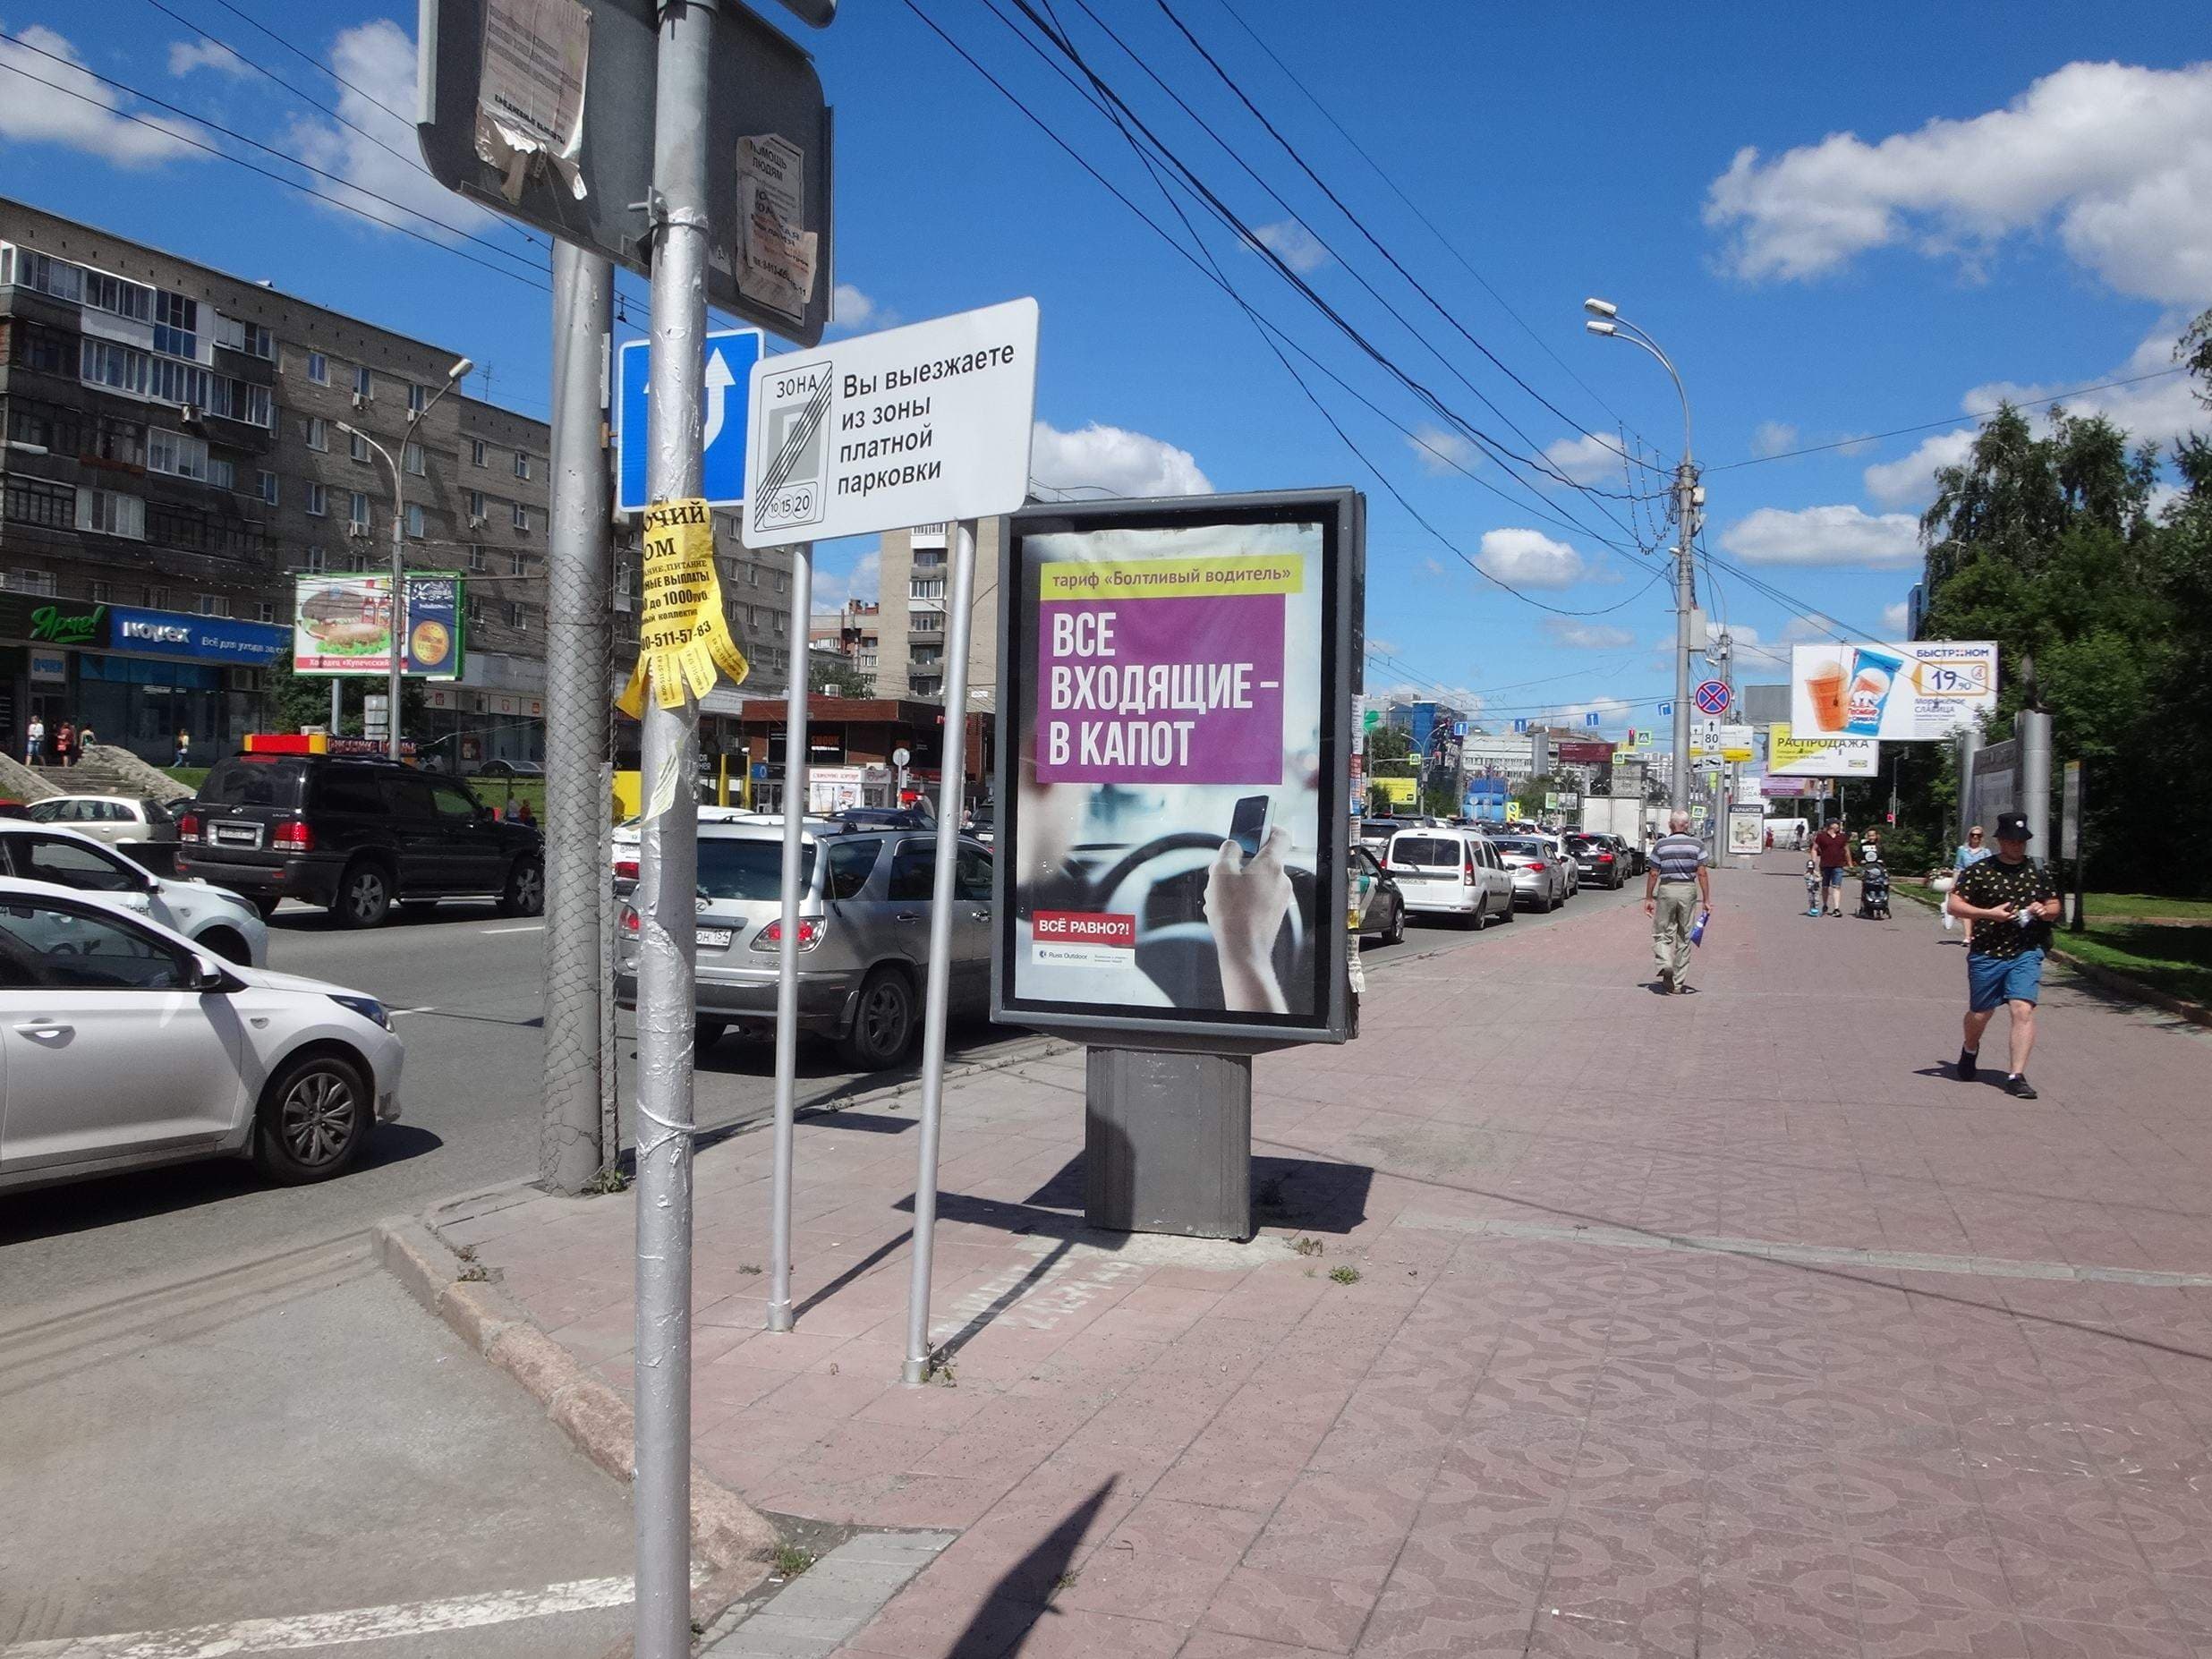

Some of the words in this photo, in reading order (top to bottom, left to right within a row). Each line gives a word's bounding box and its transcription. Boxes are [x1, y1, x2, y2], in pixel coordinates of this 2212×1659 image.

[843, 374, 878, 399] Вы
[885, 345, 1015, 390] выезжаете
[776, 374, 819, 398] ЗОНА
[842, 411, 865, 431] из
[872, 396, 932, 425] зоны
[839, 422, 932, 464] платной
[838, 460, 941, 497] парковки
[781, 498, 791, 513] 15
[794, 494, 811, 513] 20
[664, 571, 710, 587] ВЫПЛАТЫ
[1052, 571, 1100, 590] тариф
[1104, 568, 1200, 586] «Болтливый
[1205, 568, 1291, 583] водитель»
[650, 598, 661, 610] до
[201, 636, 218, 647] Всё
[219, 639, 237, 650] для
[1052, 612, 1117, 657] ВСЕ
[310, 659, 342, 668] Хоодец
[1050, 663, 1254, 715] ВХОДЯЩИЕ
[1049, 721, 1070, 766] В
[1080, 720, 1195, 767] КАПОТ
[1705, 734, 1719, 744] 80
[1777, 737, 1869, 750] РАСПРОДАЖА
[1039, 918, 1067, 932] ВСЁ
[1070, 921, 1130, 935] РАВНО?!
